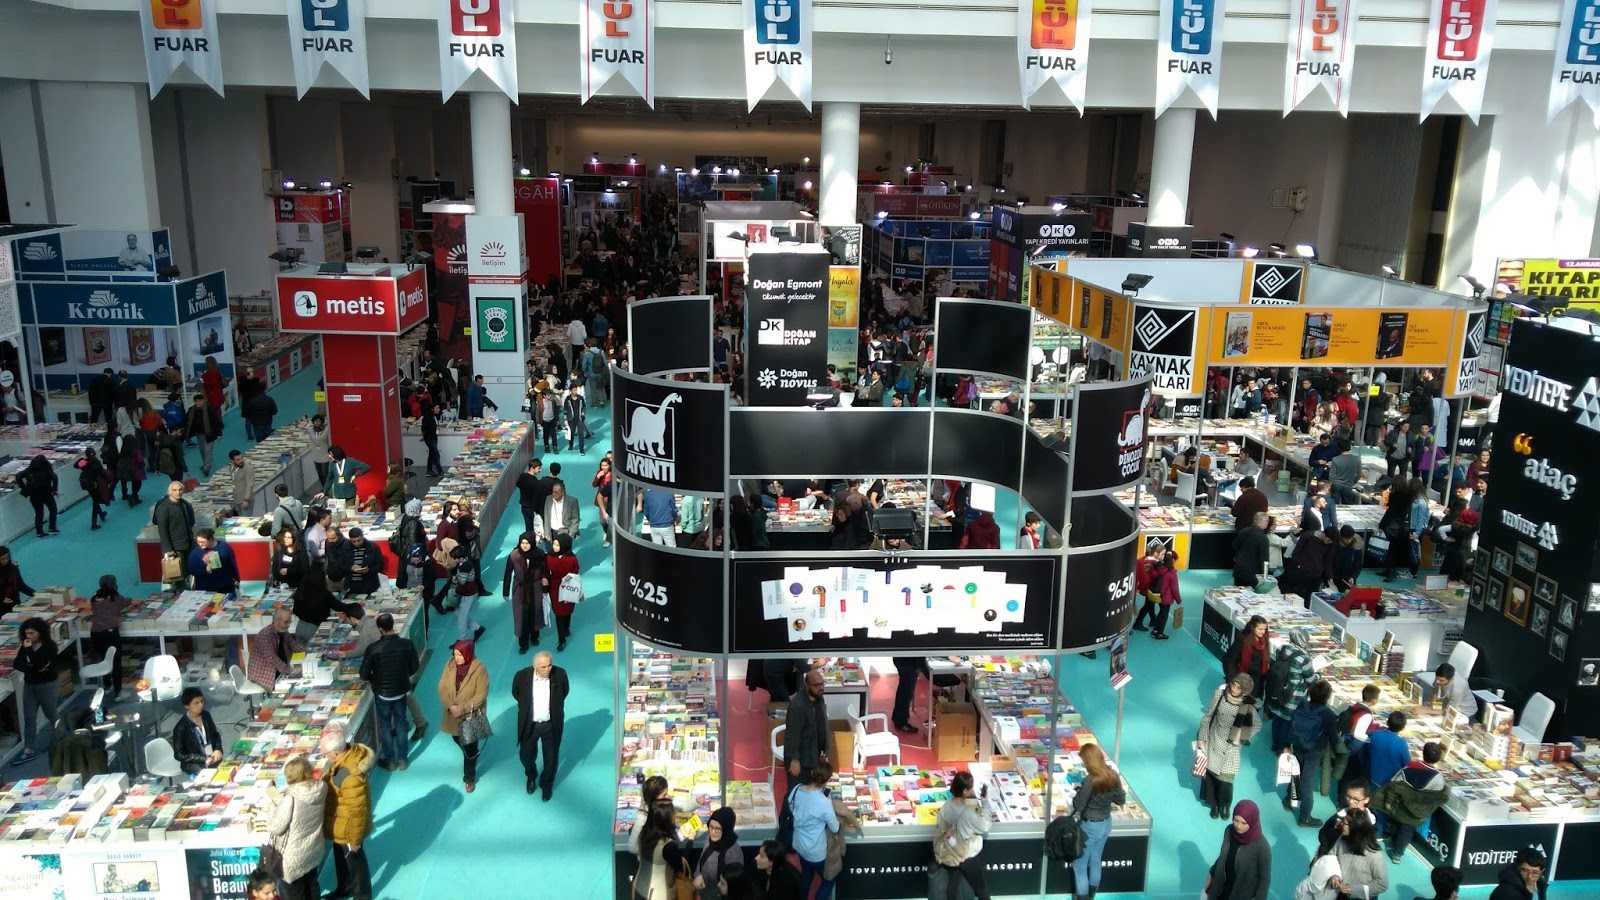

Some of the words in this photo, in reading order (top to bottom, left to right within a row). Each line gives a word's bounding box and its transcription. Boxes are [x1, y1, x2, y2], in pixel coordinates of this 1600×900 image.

[154, 37, 209, 52] FUAR
[302, 38, 354, 52] FUAR
[450, 43, 505, 57] FUAR
[591, 49, 645, 64] FUAR
[755, 51, 802, 65] FUAR
[1026, 56, 1076, 71] FUAR
[1168, 60, 1213, 74] FUAR
[1296, 62, 1340, 77] FUAR
[1432, 66, 1477, 81] FUAR
[1041, 226, 1074, 236] YKY
[449, 266, 468, 275] iletiş
[482, 259, 506, 267] iletişim
[753, 279, 785, 290] Doğan
[787, 280, 822, 290] Egmont
[188, 292, 217, 315] Kronik
[407, 286, 424, 307] metis
[67, 303, 145, 320] Kronik
[326, 297, 385, 315] metis
[761, 320, 781, 331] DK
[784, 329, 816, 338] DOĞAN
[1130, 353, 1191, 375] KAYNAK
[780, 369, 808, 378] Doğan
[780, 378, 817, 389] novus
[1504, 364, 1573, 412] YEDİTEPE
[626, 453, 676, 482] AYRINTI
[1524, 457, 1577, 501] ataç
[1502, 509, 1539, 539] YEDİTEPE
[629, 575, 668, 606] %25
[1108, 572, 1135, 601] %50
[211, 861, 257, 876] Simone
[213, 878, 249, 894] Beauv
